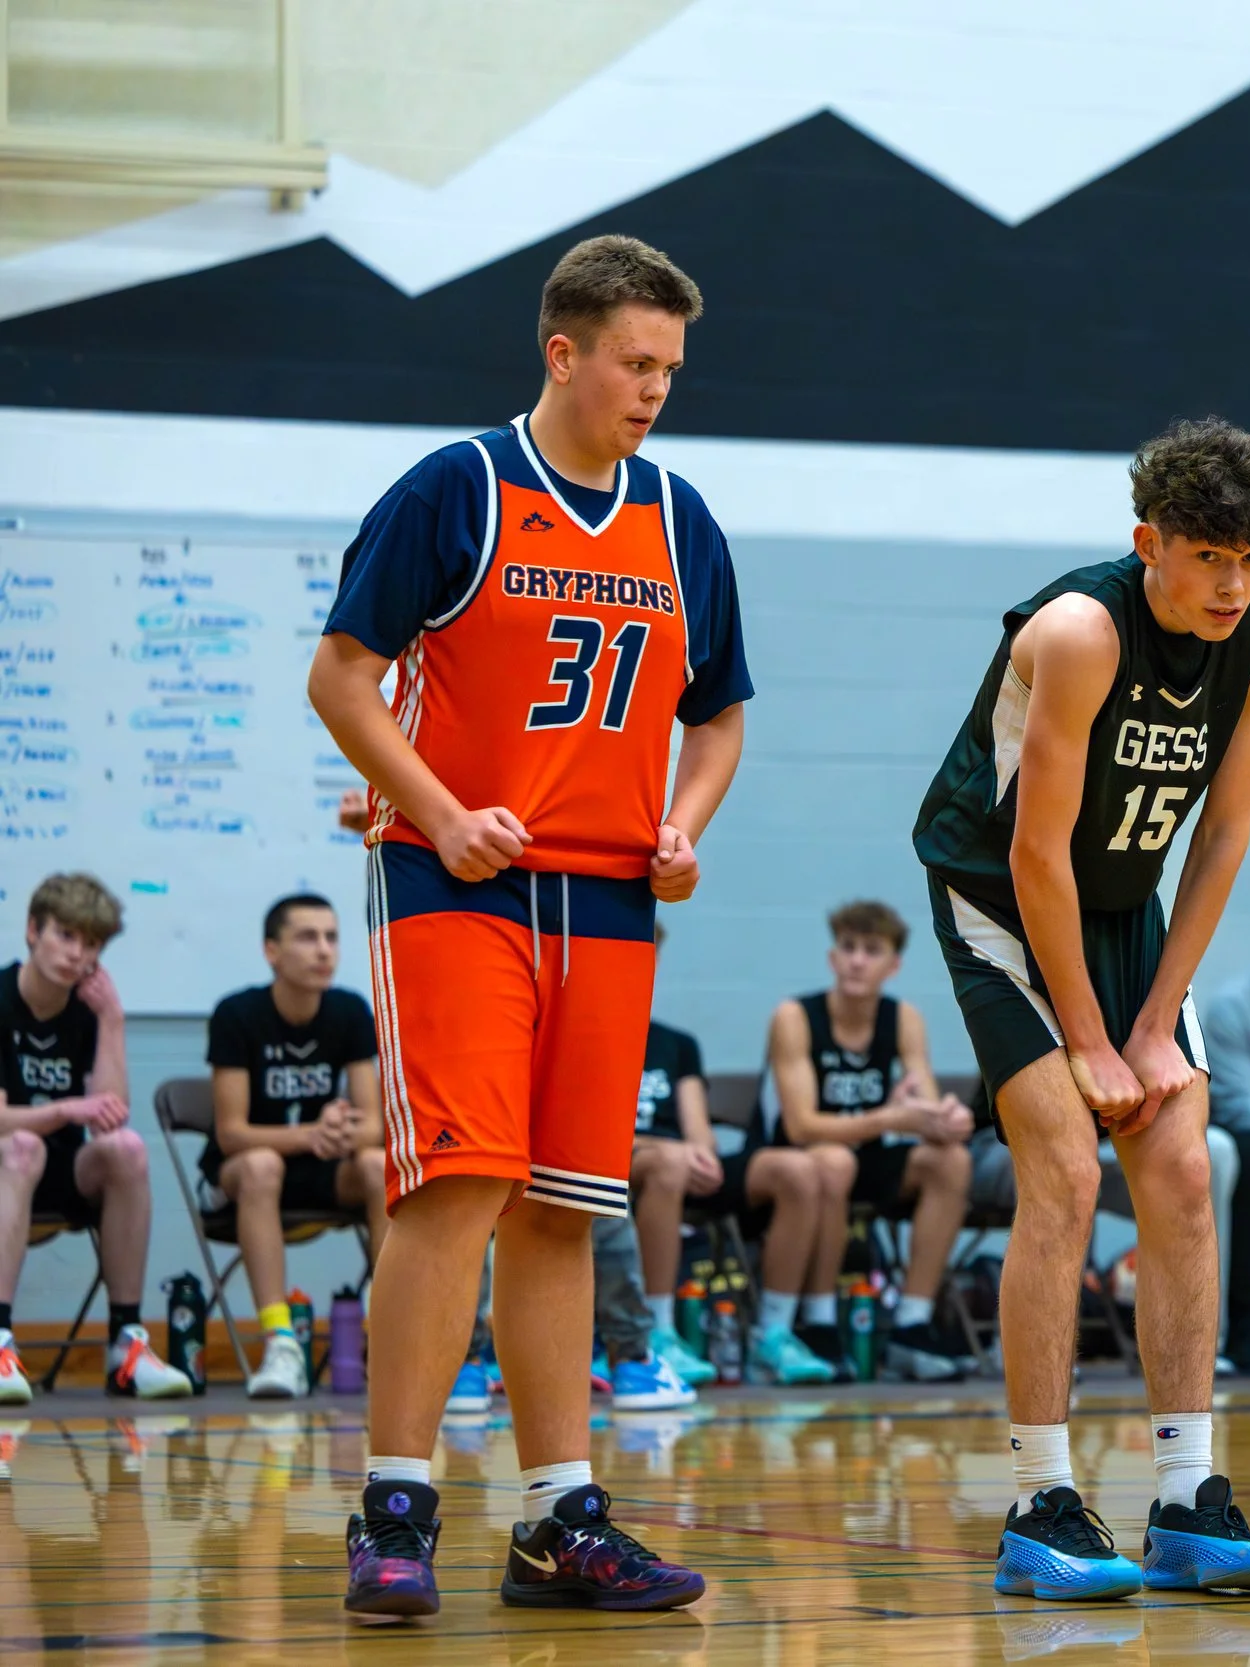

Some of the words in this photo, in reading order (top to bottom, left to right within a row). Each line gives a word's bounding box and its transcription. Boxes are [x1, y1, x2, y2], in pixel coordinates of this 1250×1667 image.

[502, 563, 676, 616] GRYPHONS
[525, 614, 651, 733] 31
[1114, 719, 1208, 772] GESS
[1107, 785, 1188, 851] 15
[19, 1054, 72, 1091] ESS
[266, 1062, 332, 1099] GESS
